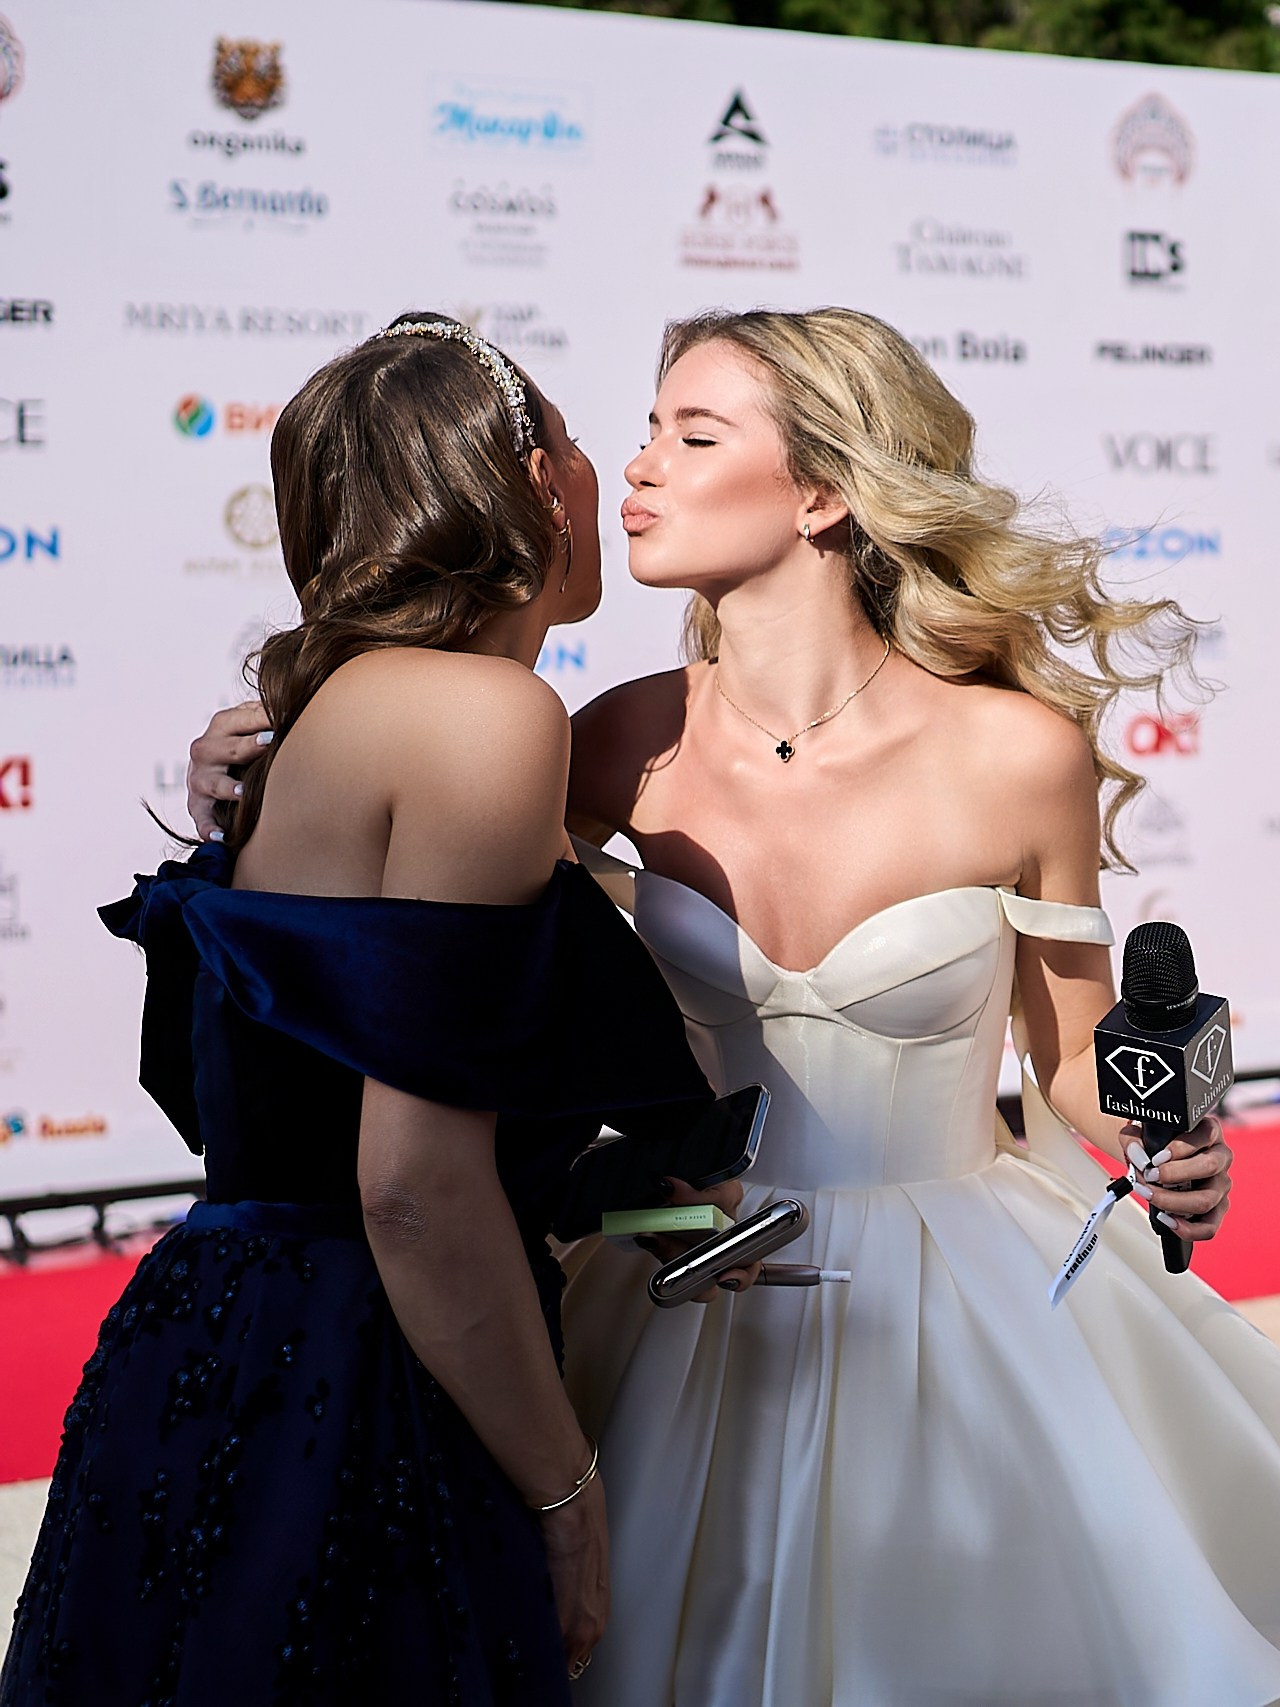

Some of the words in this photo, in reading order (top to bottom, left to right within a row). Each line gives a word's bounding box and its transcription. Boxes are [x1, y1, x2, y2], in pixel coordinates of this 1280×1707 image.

[190, 130, 306, 158] organika
[1104, 432, 1218, 474] VOICE
[1105, 1093, 1183, 1126] fashiontv
[1191, 1071, 1231, 1122] fashiontv
